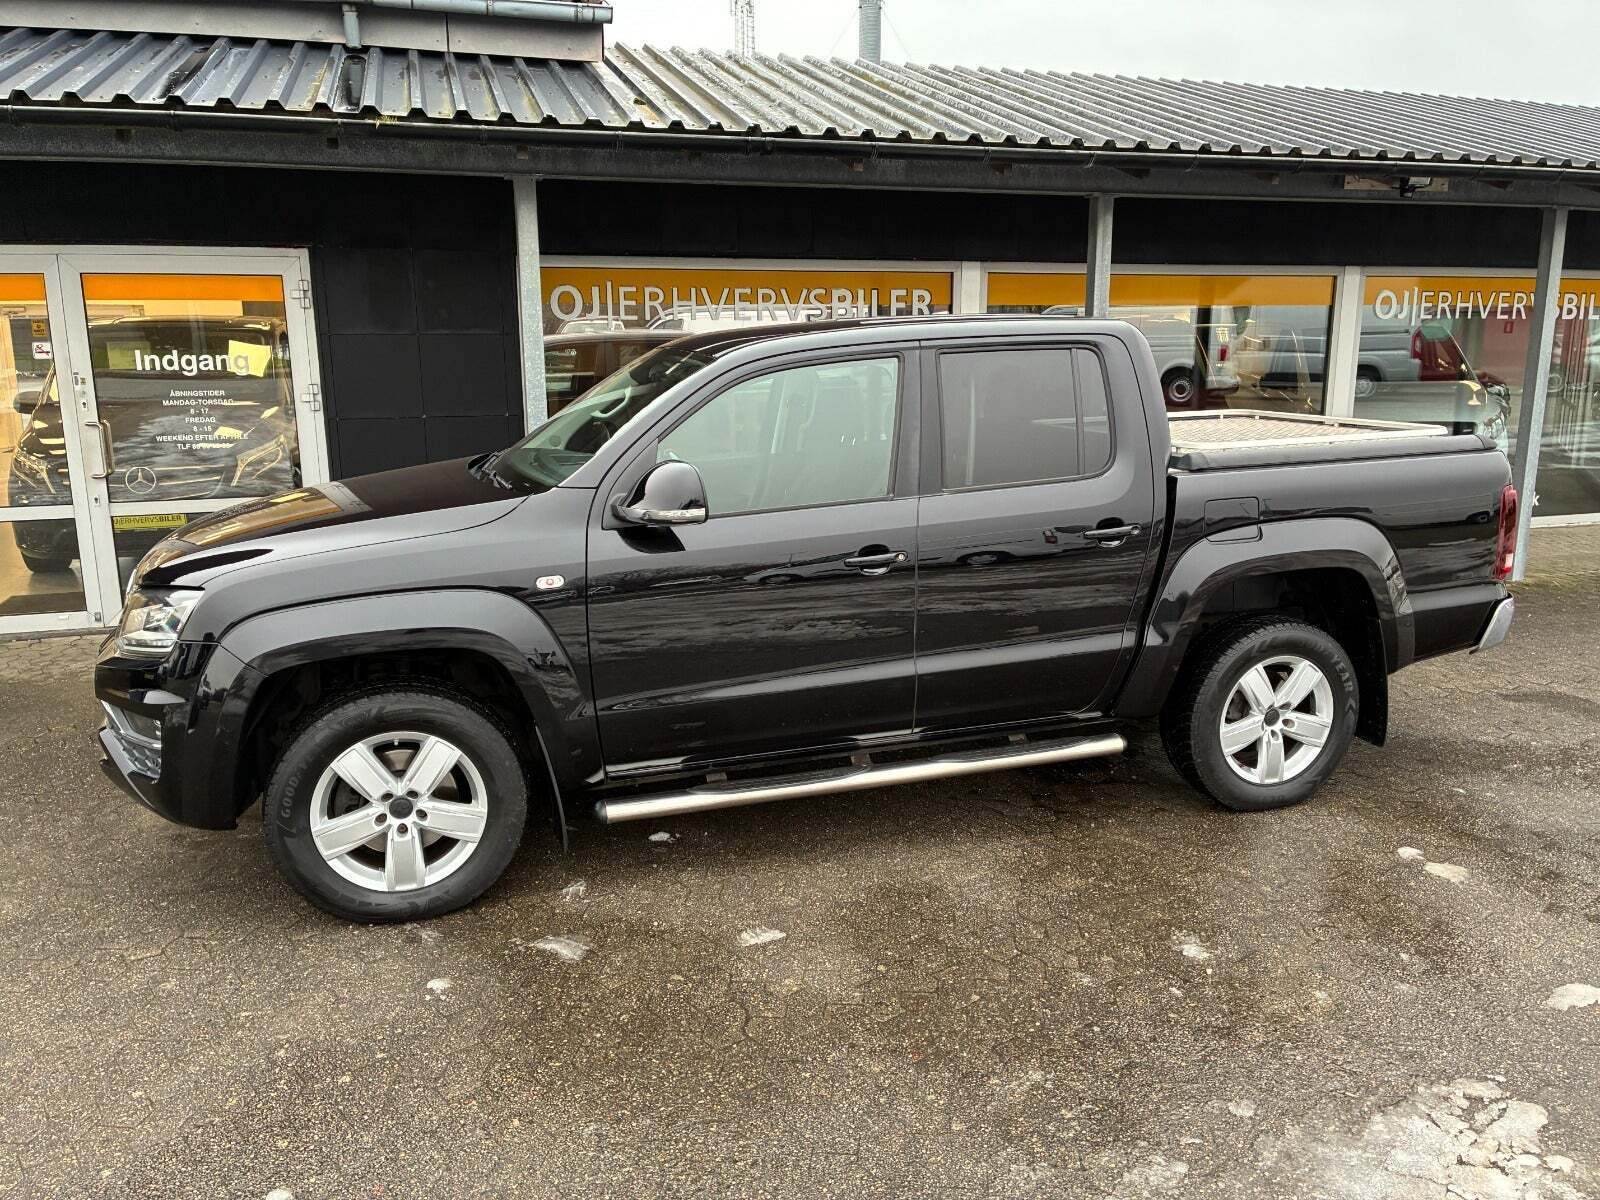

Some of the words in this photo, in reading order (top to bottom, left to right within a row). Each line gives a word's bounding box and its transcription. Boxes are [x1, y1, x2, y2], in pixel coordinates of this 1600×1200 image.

[134, 349, 249, 376] Indgang
[169, 389, 225, 397] ÅBNINGSTIDER
[185, 416, 216, 424] FREDAG
[155, 434, 194, 442] WEEKEND
[195, 433, 219, 442] EFTER
